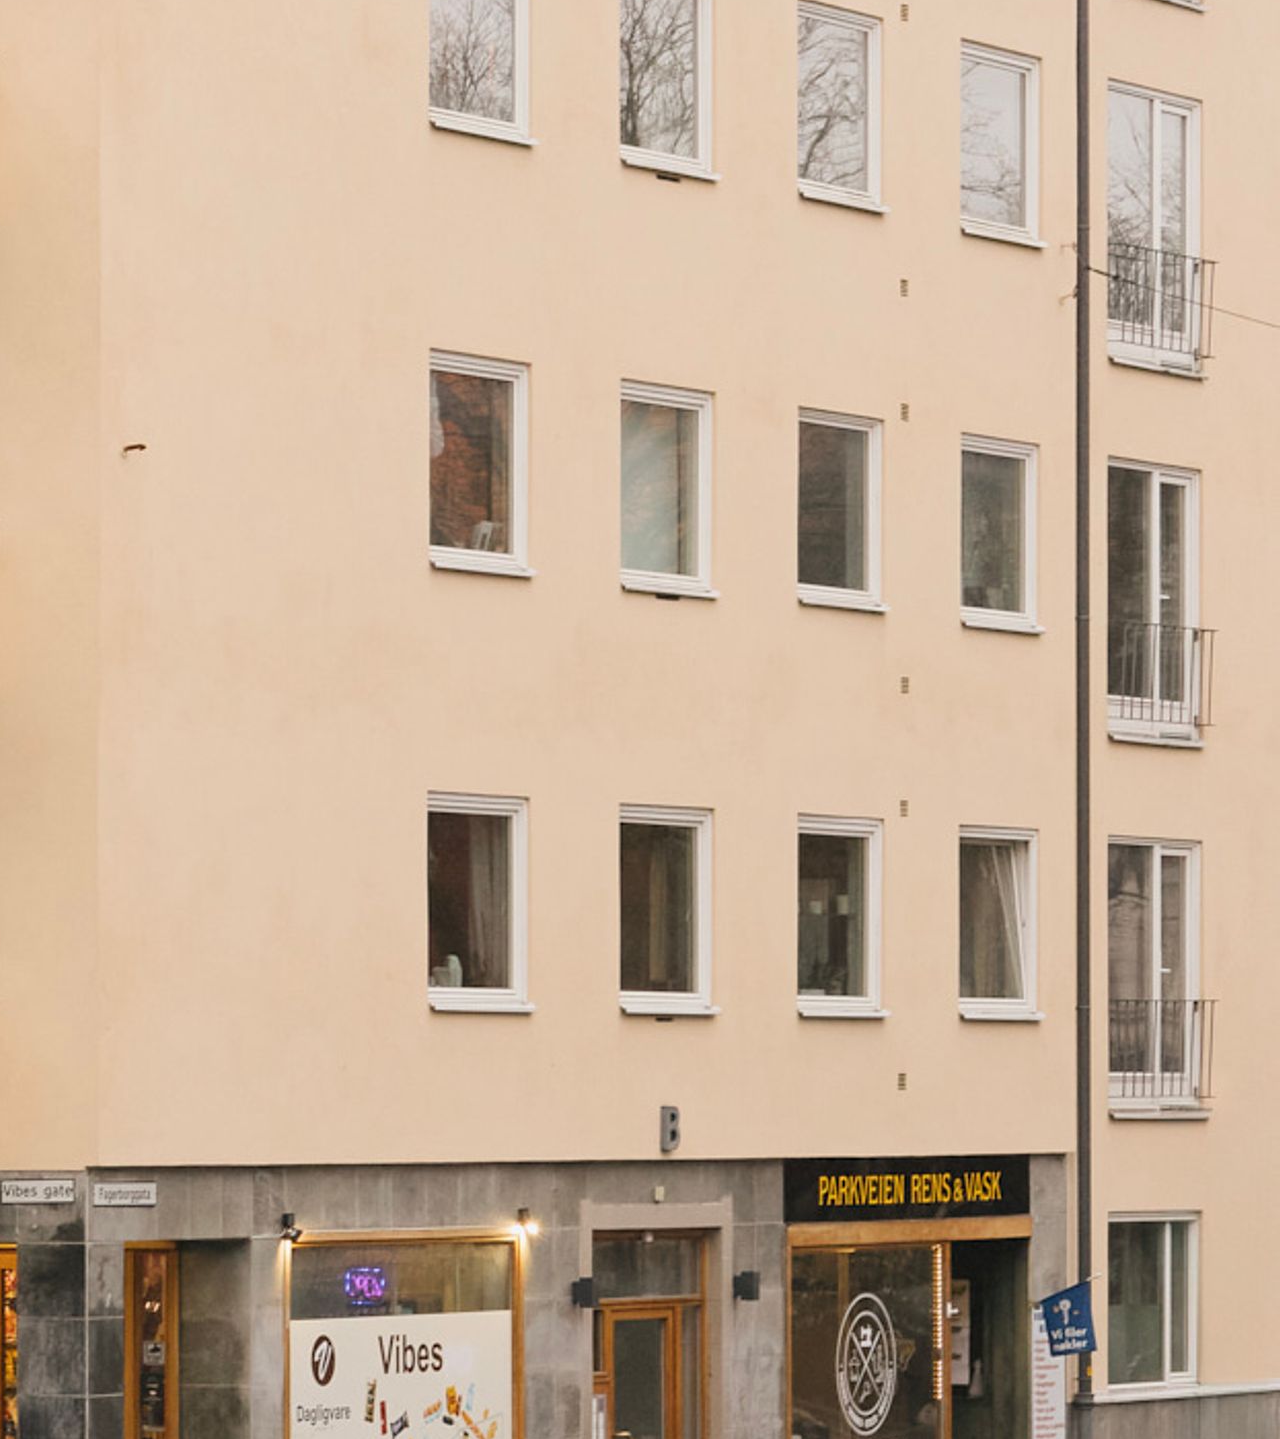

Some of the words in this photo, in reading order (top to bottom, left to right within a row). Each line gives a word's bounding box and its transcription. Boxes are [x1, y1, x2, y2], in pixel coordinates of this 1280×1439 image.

[3, 1184, 37, 1197] Vibes
[44, 1184, 73, 1199] gate
[818, 1175, 905, 1206] PARKVEIEN
[911, 1172, 951, 1204] RENS
[964, 1171, 1002, 1201] VASK
[378, 1334, 443, 1374] Vibes
[296, 1405, 351, 1426] Dagligvare
